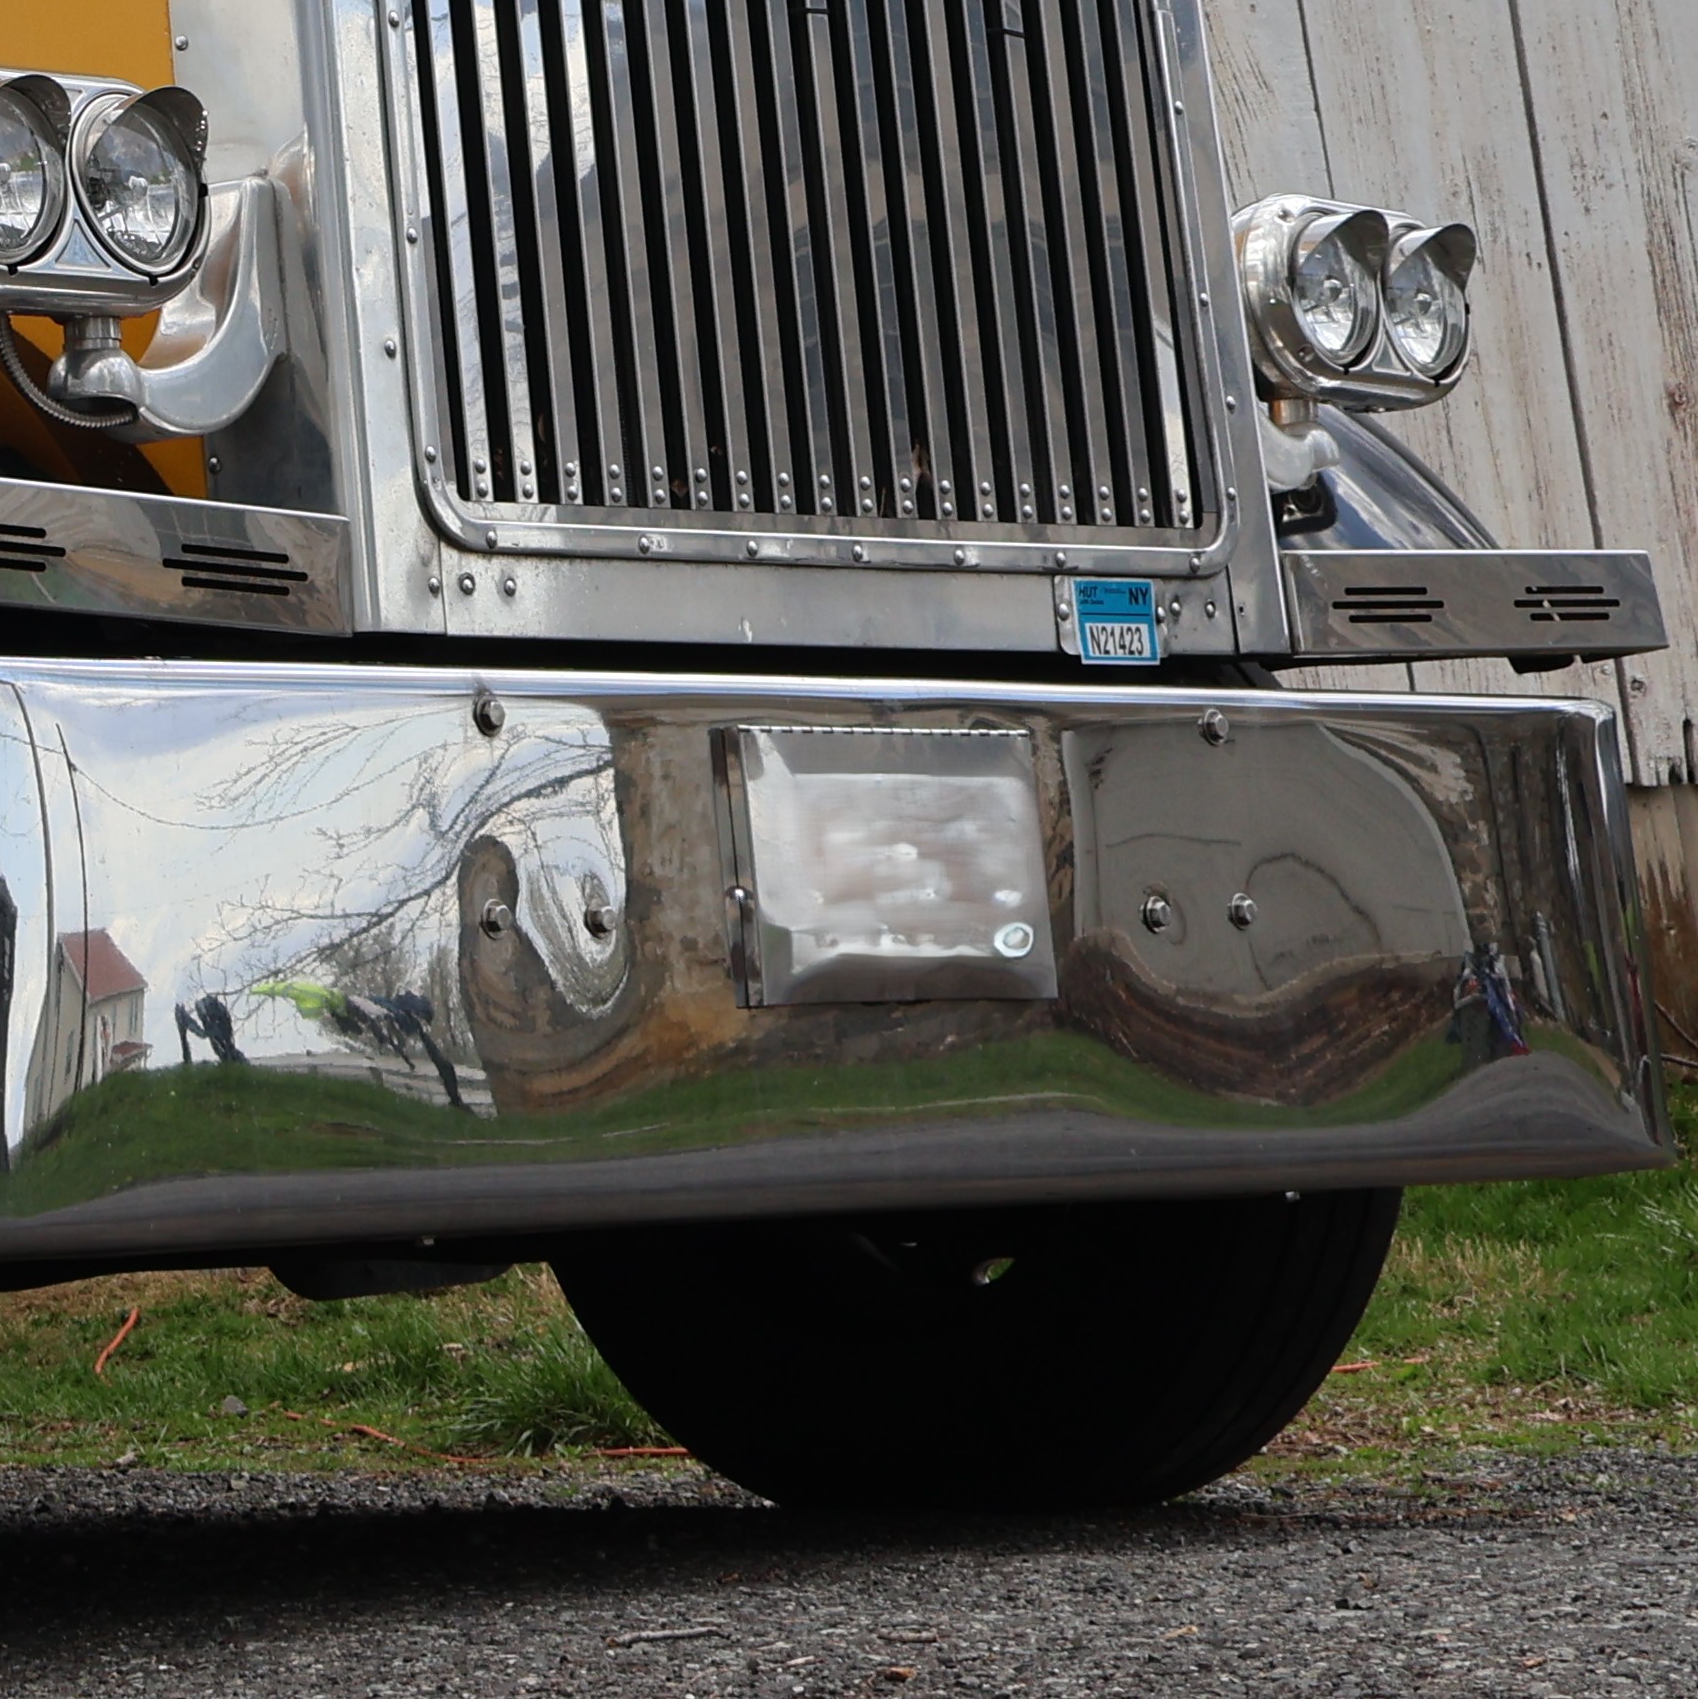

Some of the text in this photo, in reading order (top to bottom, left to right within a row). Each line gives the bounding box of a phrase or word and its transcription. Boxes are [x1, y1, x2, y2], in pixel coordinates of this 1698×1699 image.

[1079, 586, 1099, 597] HUT
[1128, 587, 1149, 606] NY
[1089, 625, 1144, 656] N21423
